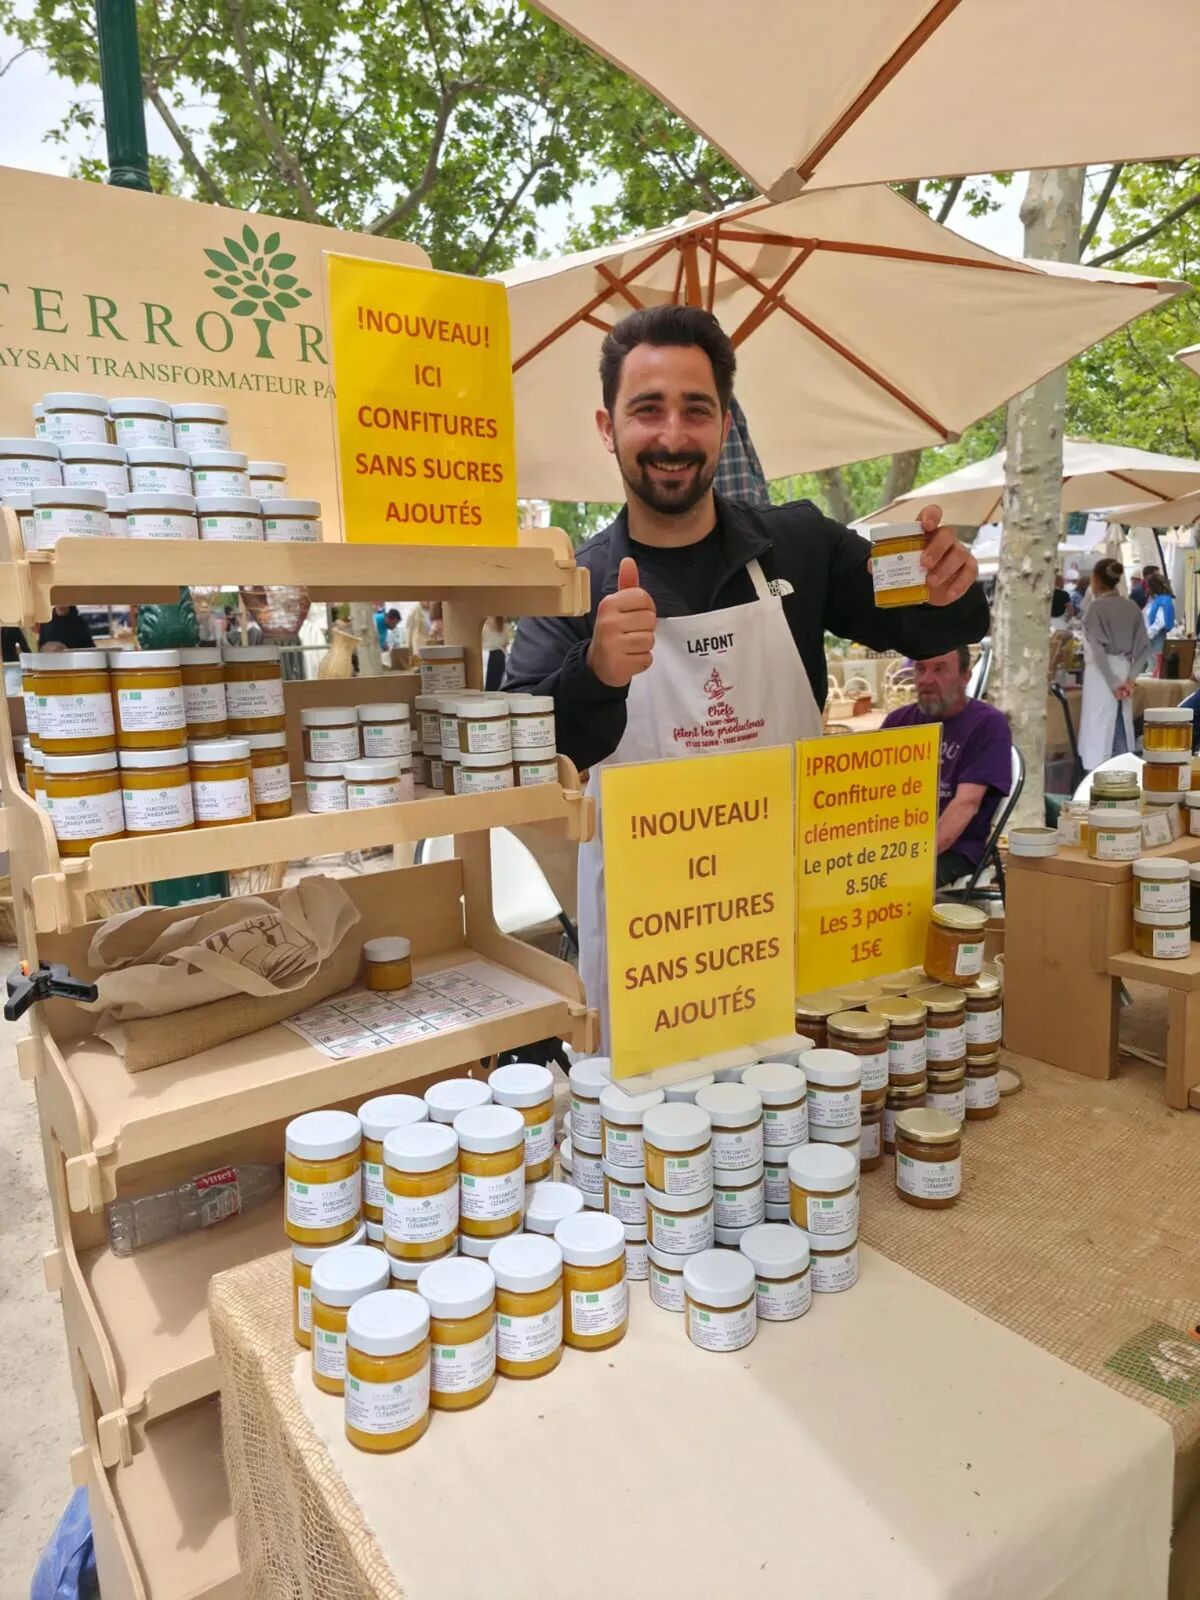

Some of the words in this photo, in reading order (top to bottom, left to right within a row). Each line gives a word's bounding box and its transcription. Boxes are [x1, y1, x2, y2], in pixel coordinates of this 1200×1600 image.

[0, 283, 329, 365] ERROIR
[358, 306, 490, 348] !NOUVEAU!
[87, 356, 307, 396] TRANSFORMATEUR
[414, 364, 442, 388] ICI
[358, 405, 498, 438] CONFITURES
[355, 453, 417, 477] SANS
[423, 458, 503, 483] SUCRES
[385, 499, 482, 526] AJOUTÉS
[687, 633, 734, 654] LAFONT
[708, 704, 734, 720] Chefs
[674, 727, 699, 742] fêtent
[701, 725, 715, 737] les
[717, 718, 765, 739] producteurs
[806, 741, 932, 776] !PROMOTION!
[814, 783, 896, 809] Confiture
[902, 776, 922, 794] de
[631, 797, 769, 839] !NOUVEAU!
[804, 813, 899, 845] clémentine
[904, 808, 929, 825] bio
[688, 854, 717, 879] ICI
[804, 859, 821, 875] Le
[826, 852, 852, 874] pot
[857, 846, 876, 864] de
[880, 841, 907, 861] 220
[911, 844, 919, 858] g
[846, 872, 888, 896] 8.50€
[628, 892, 774, 939] CONFITURES
[820, 913, 848, 935] Les
[851, 908, 862, 928] 3
[866, 902, 903, 929] pots
[625, 956, 688, 990] SANS
[695, 937, 780, 975] SUCRES
[851, 938, 882, 963] 15€
[654, 985, 756, 1032] AJOUTÉS
[201, 1170, 232, 1185] Vittel
